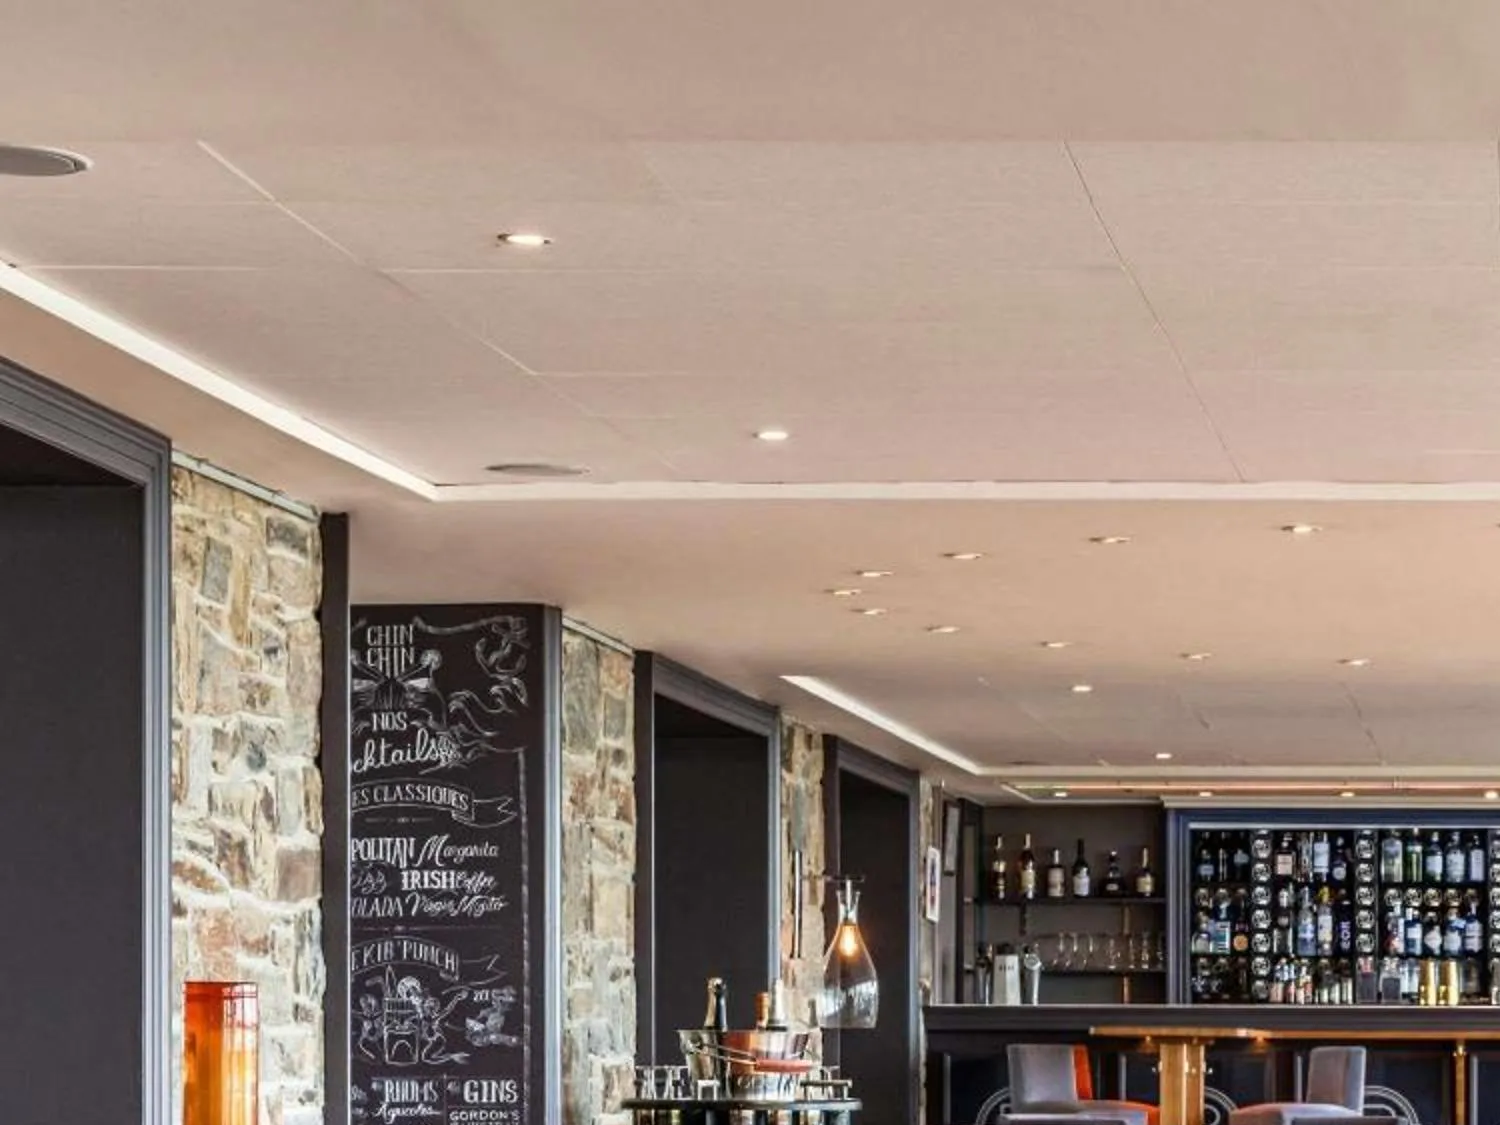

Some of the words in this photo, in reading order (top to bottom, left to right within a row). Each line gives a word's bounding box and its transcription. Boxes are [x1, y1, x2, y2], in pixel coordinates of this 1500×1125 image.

[367, 623, 414, 647] CHIN
[367, 646, 415, 680] CHIN
[372, 711, 408, 732] NOS
[373, 783, 469, 811] CLASSIQUES
[412, 834, 499, 868] Margarita
[401, 869, 455, 890] IRISH
[463, 1079, 519, 1103] GINS
